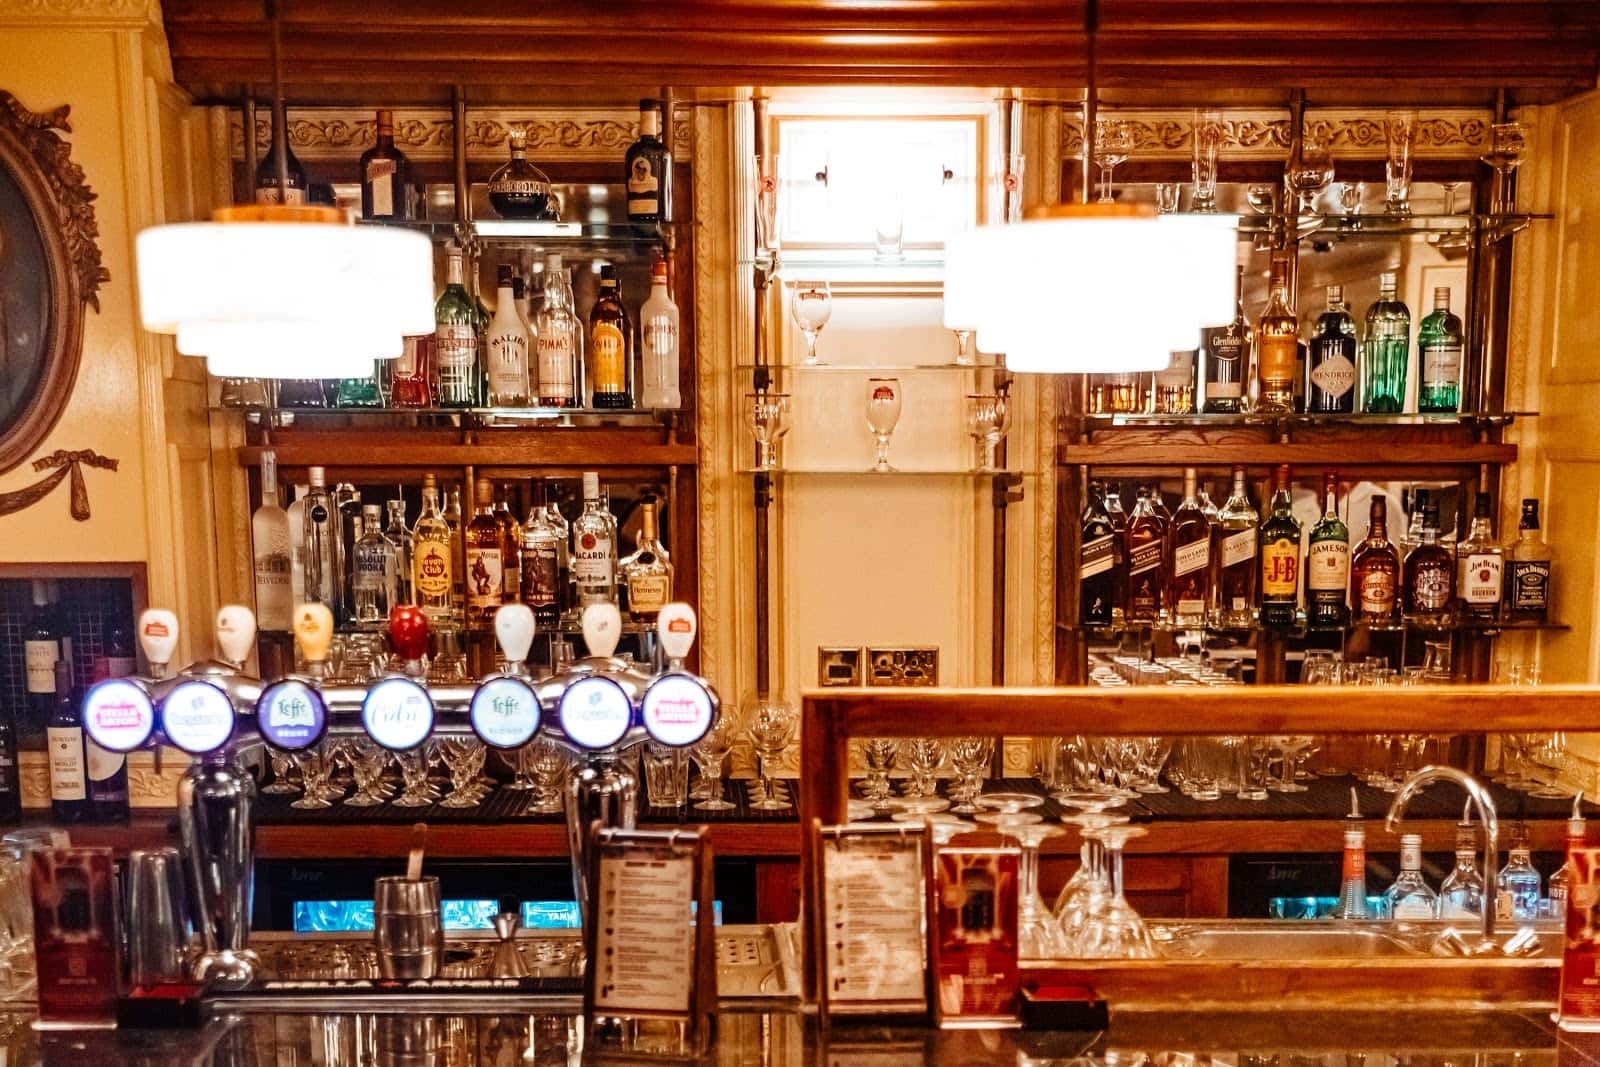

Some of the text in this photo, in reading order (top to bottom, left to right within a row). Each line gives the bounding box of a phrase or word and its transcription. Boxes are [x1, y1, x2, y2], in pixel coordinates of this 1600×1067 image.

[540, 337, 568, 350] PIMM'S
[425, 565, 442, 573] Club
[1267, 556, 1296, 583] J&B
